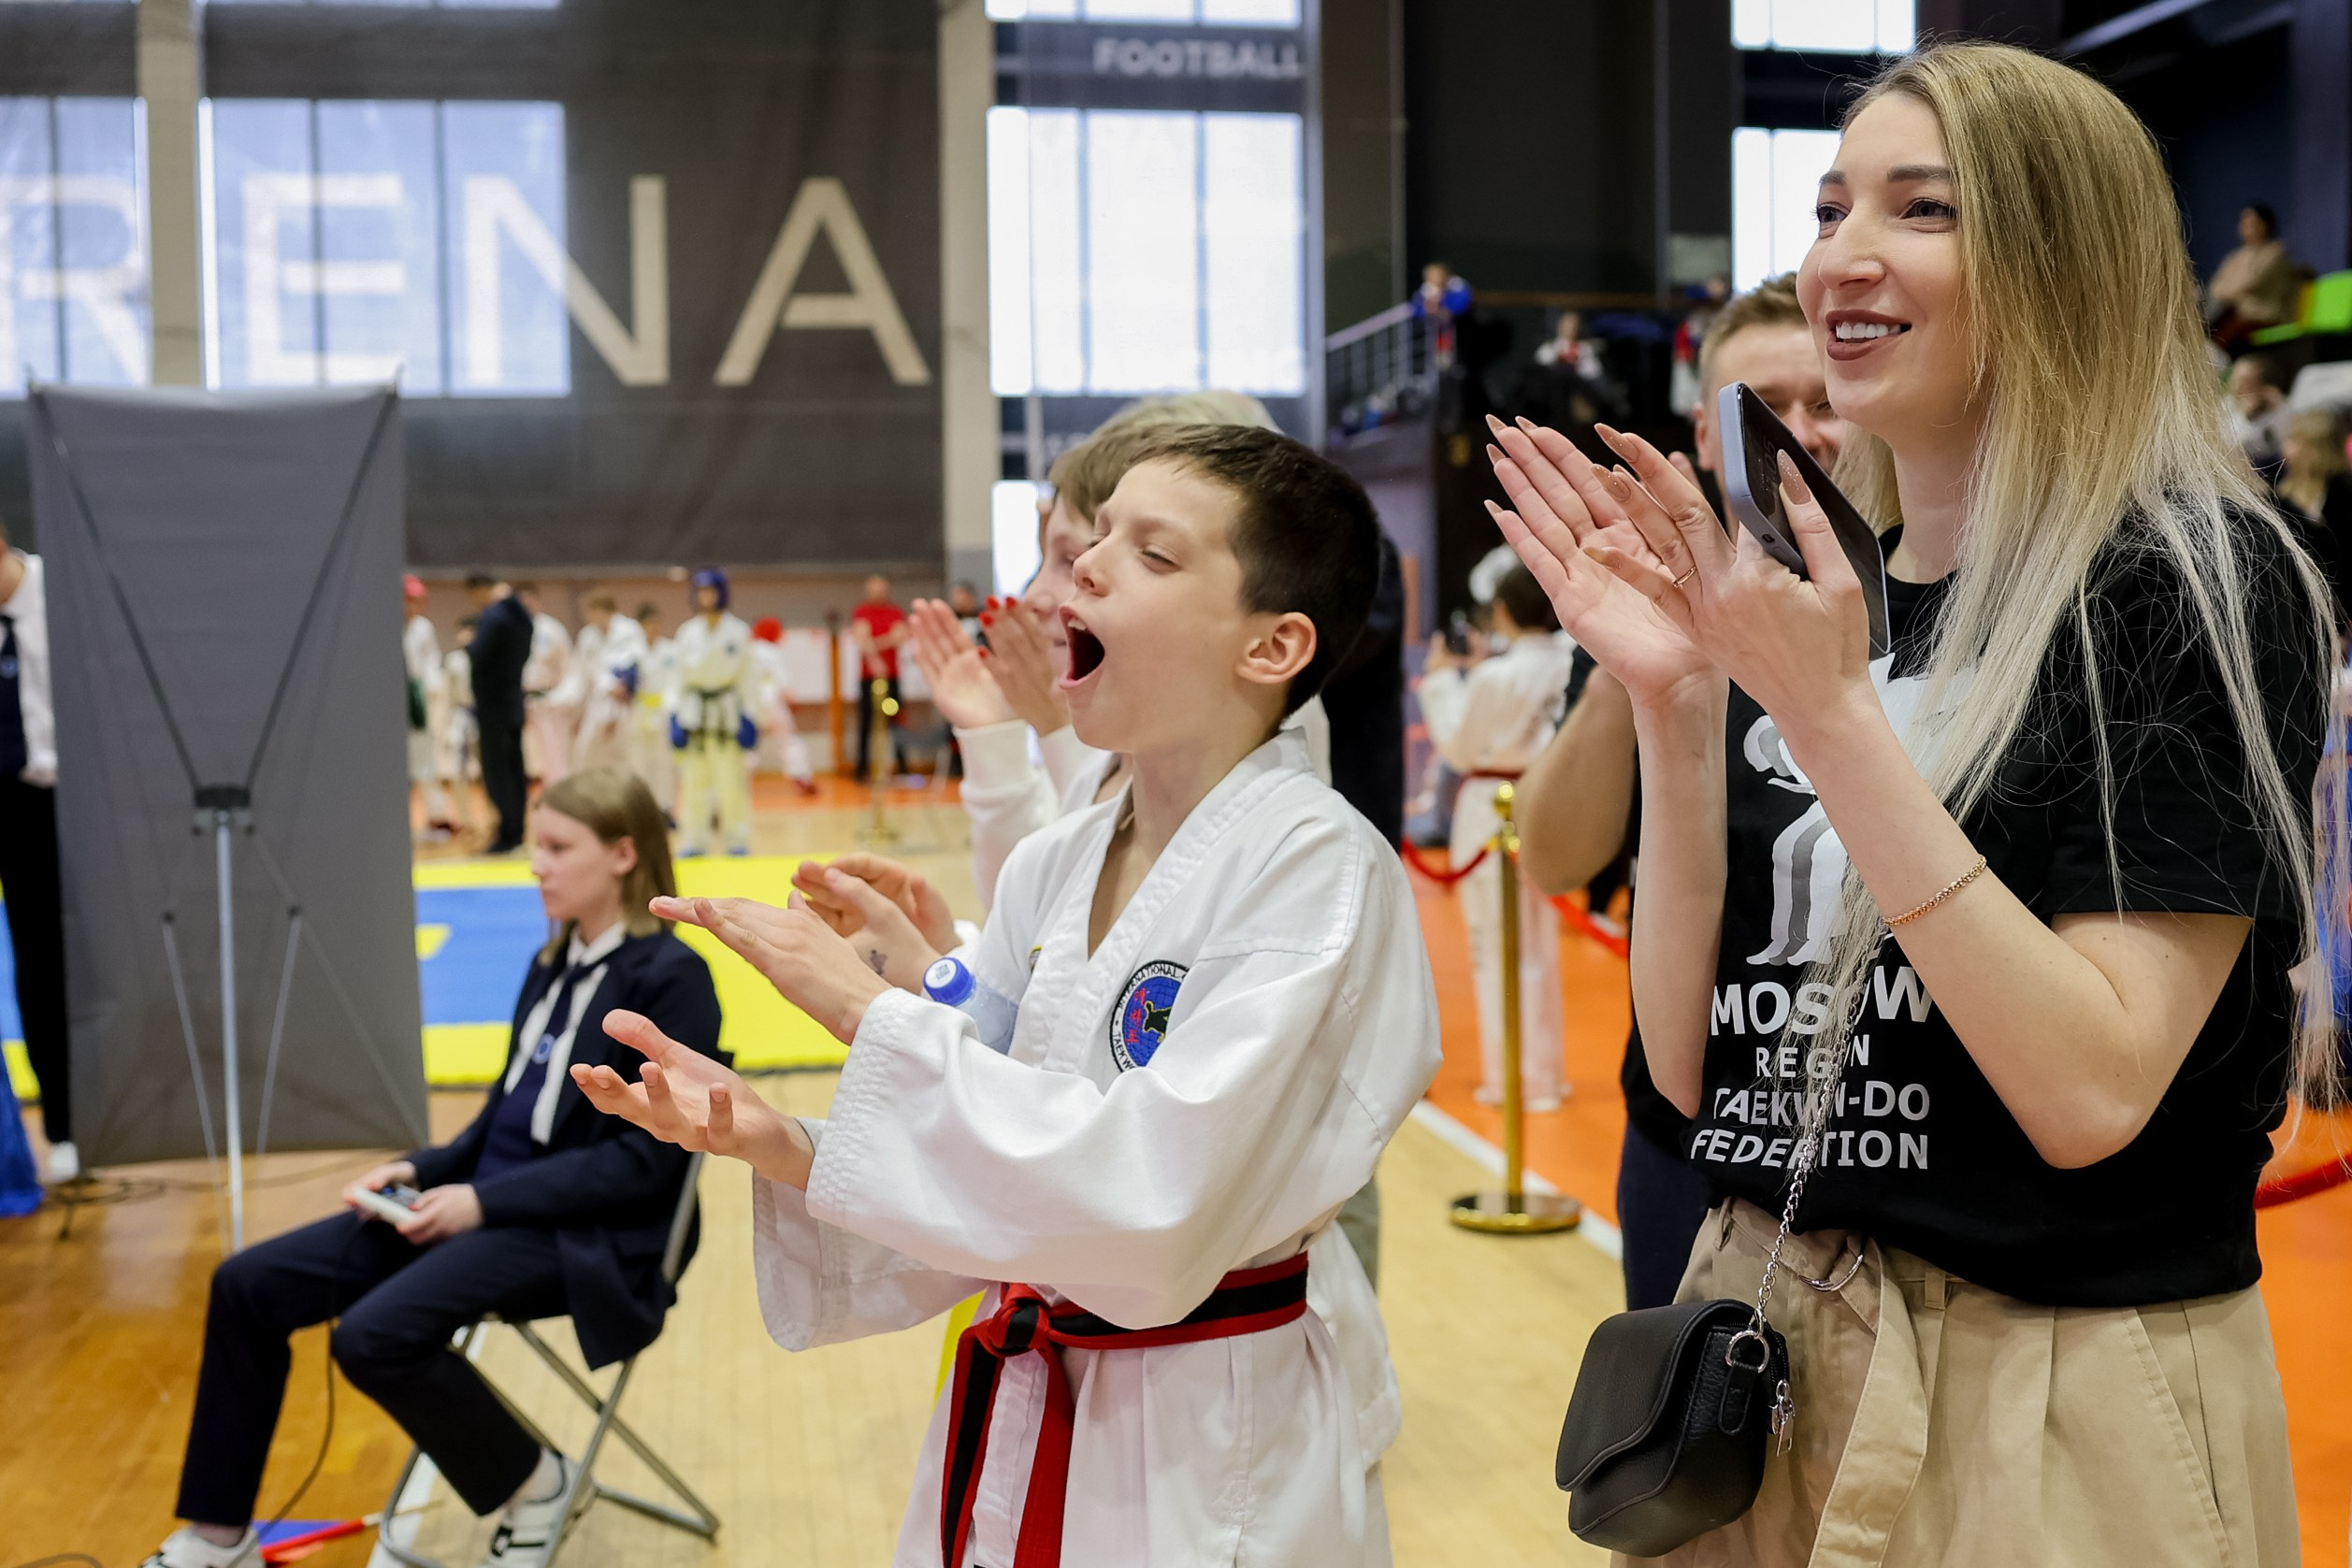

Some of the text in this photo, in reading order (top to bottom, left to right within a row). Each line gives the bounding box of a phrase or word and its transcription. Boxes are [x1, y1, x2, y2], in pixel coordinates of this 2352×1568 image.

[1092, 37, 1303, 79] FOOTBALL
[1710, 965, 1933, 1036] MOSW
[1755, 1034, 1870, 1080] REGN
[1713, 1080, 1930, 1127] TAEKWN-DO
[1690, 1129, 1928, 1170] FEDERTION
